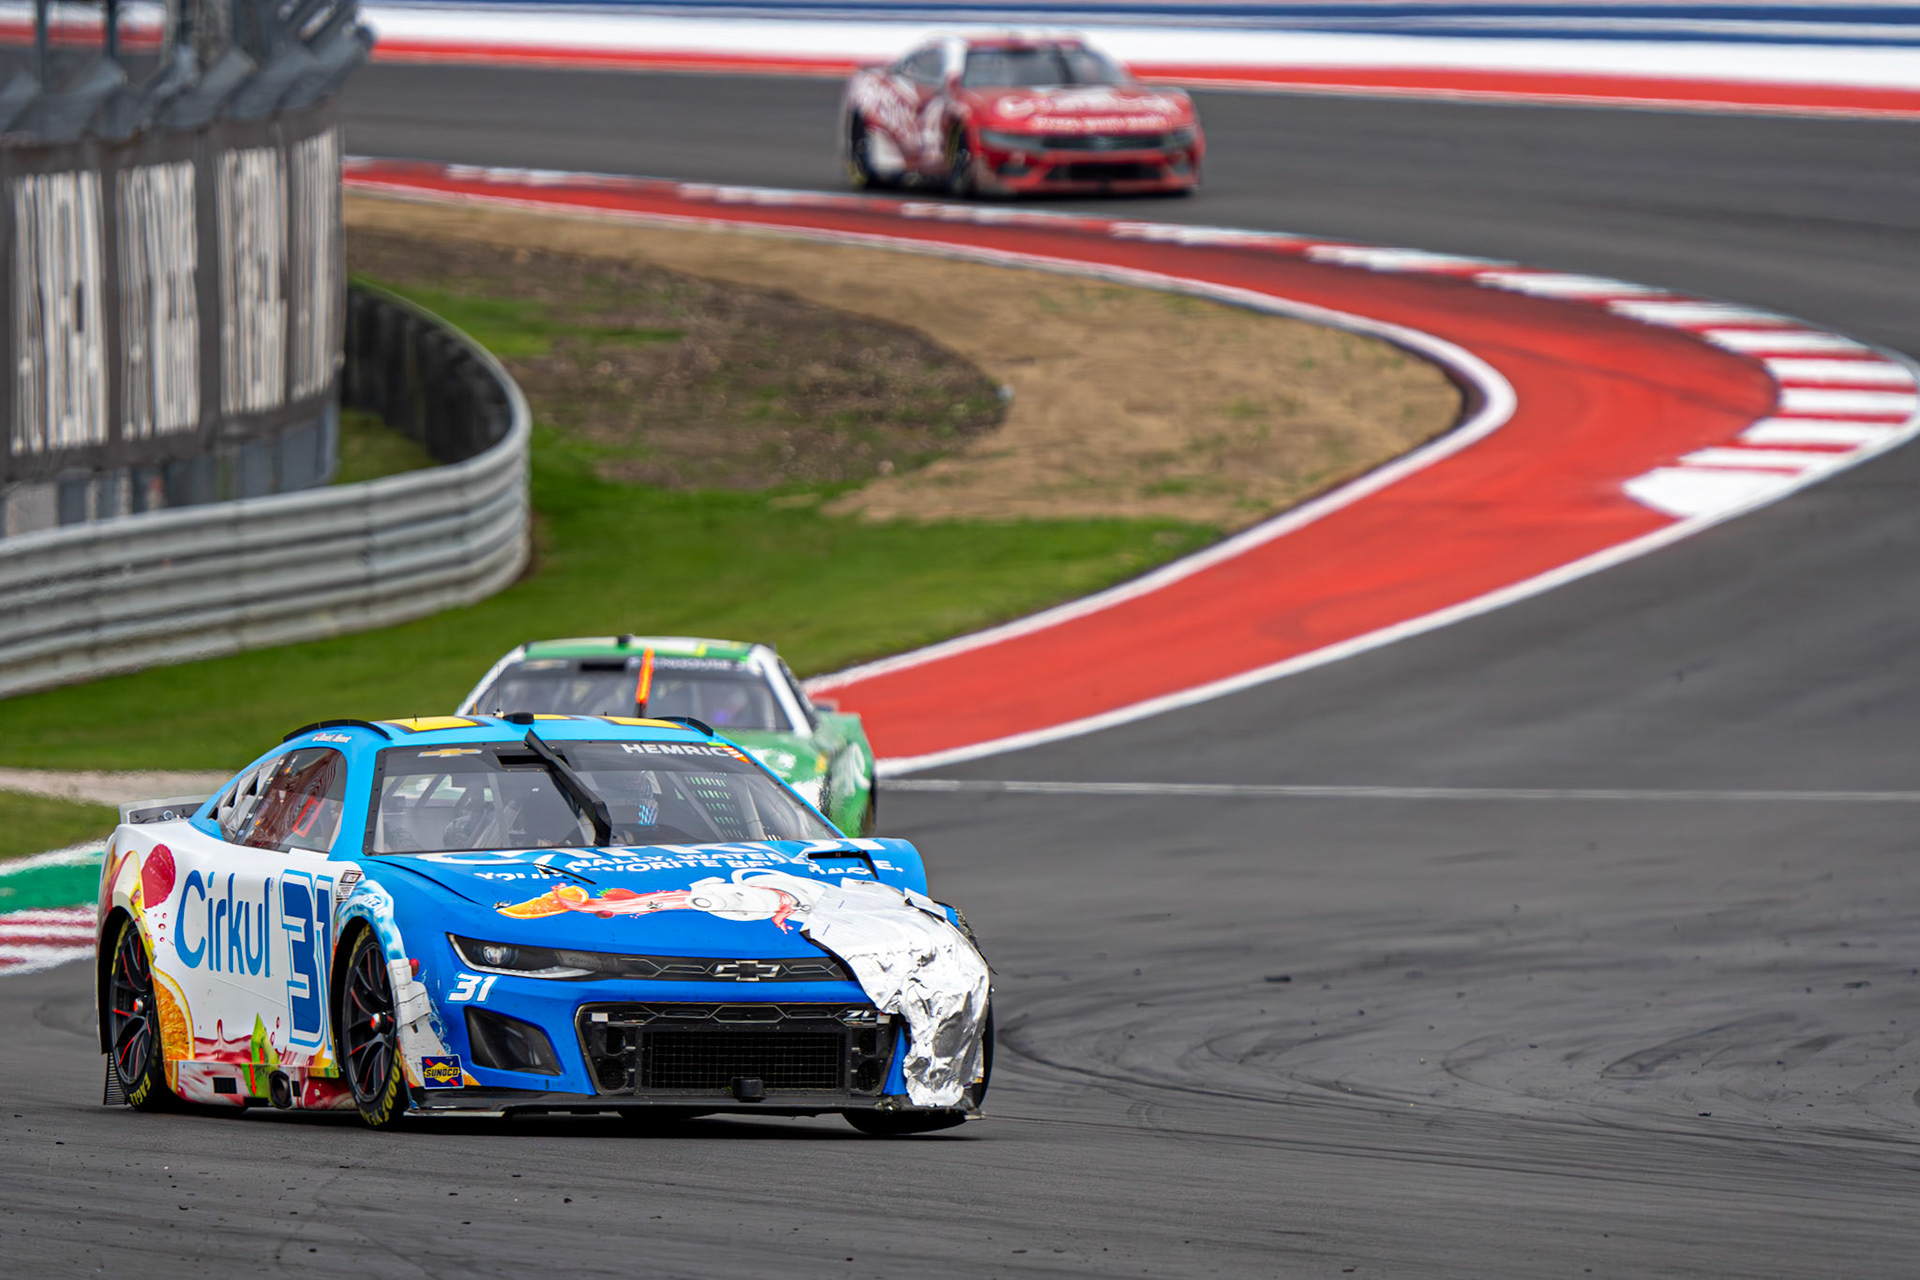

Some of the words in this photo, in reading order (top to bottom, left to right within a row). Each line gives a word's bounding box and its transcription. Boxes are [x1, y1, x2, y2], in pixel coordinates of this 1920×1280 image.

[621, 744, 732, 757] HEMRIC
[174, 869, 271, 978] Cirkul
[279, 869, 334, 1051] 31
[446, 972, 500, 1003] 31
[425, 1067, 460, 1078] SUNOCO
[129, 1072, 151, 1106] EAGLE
